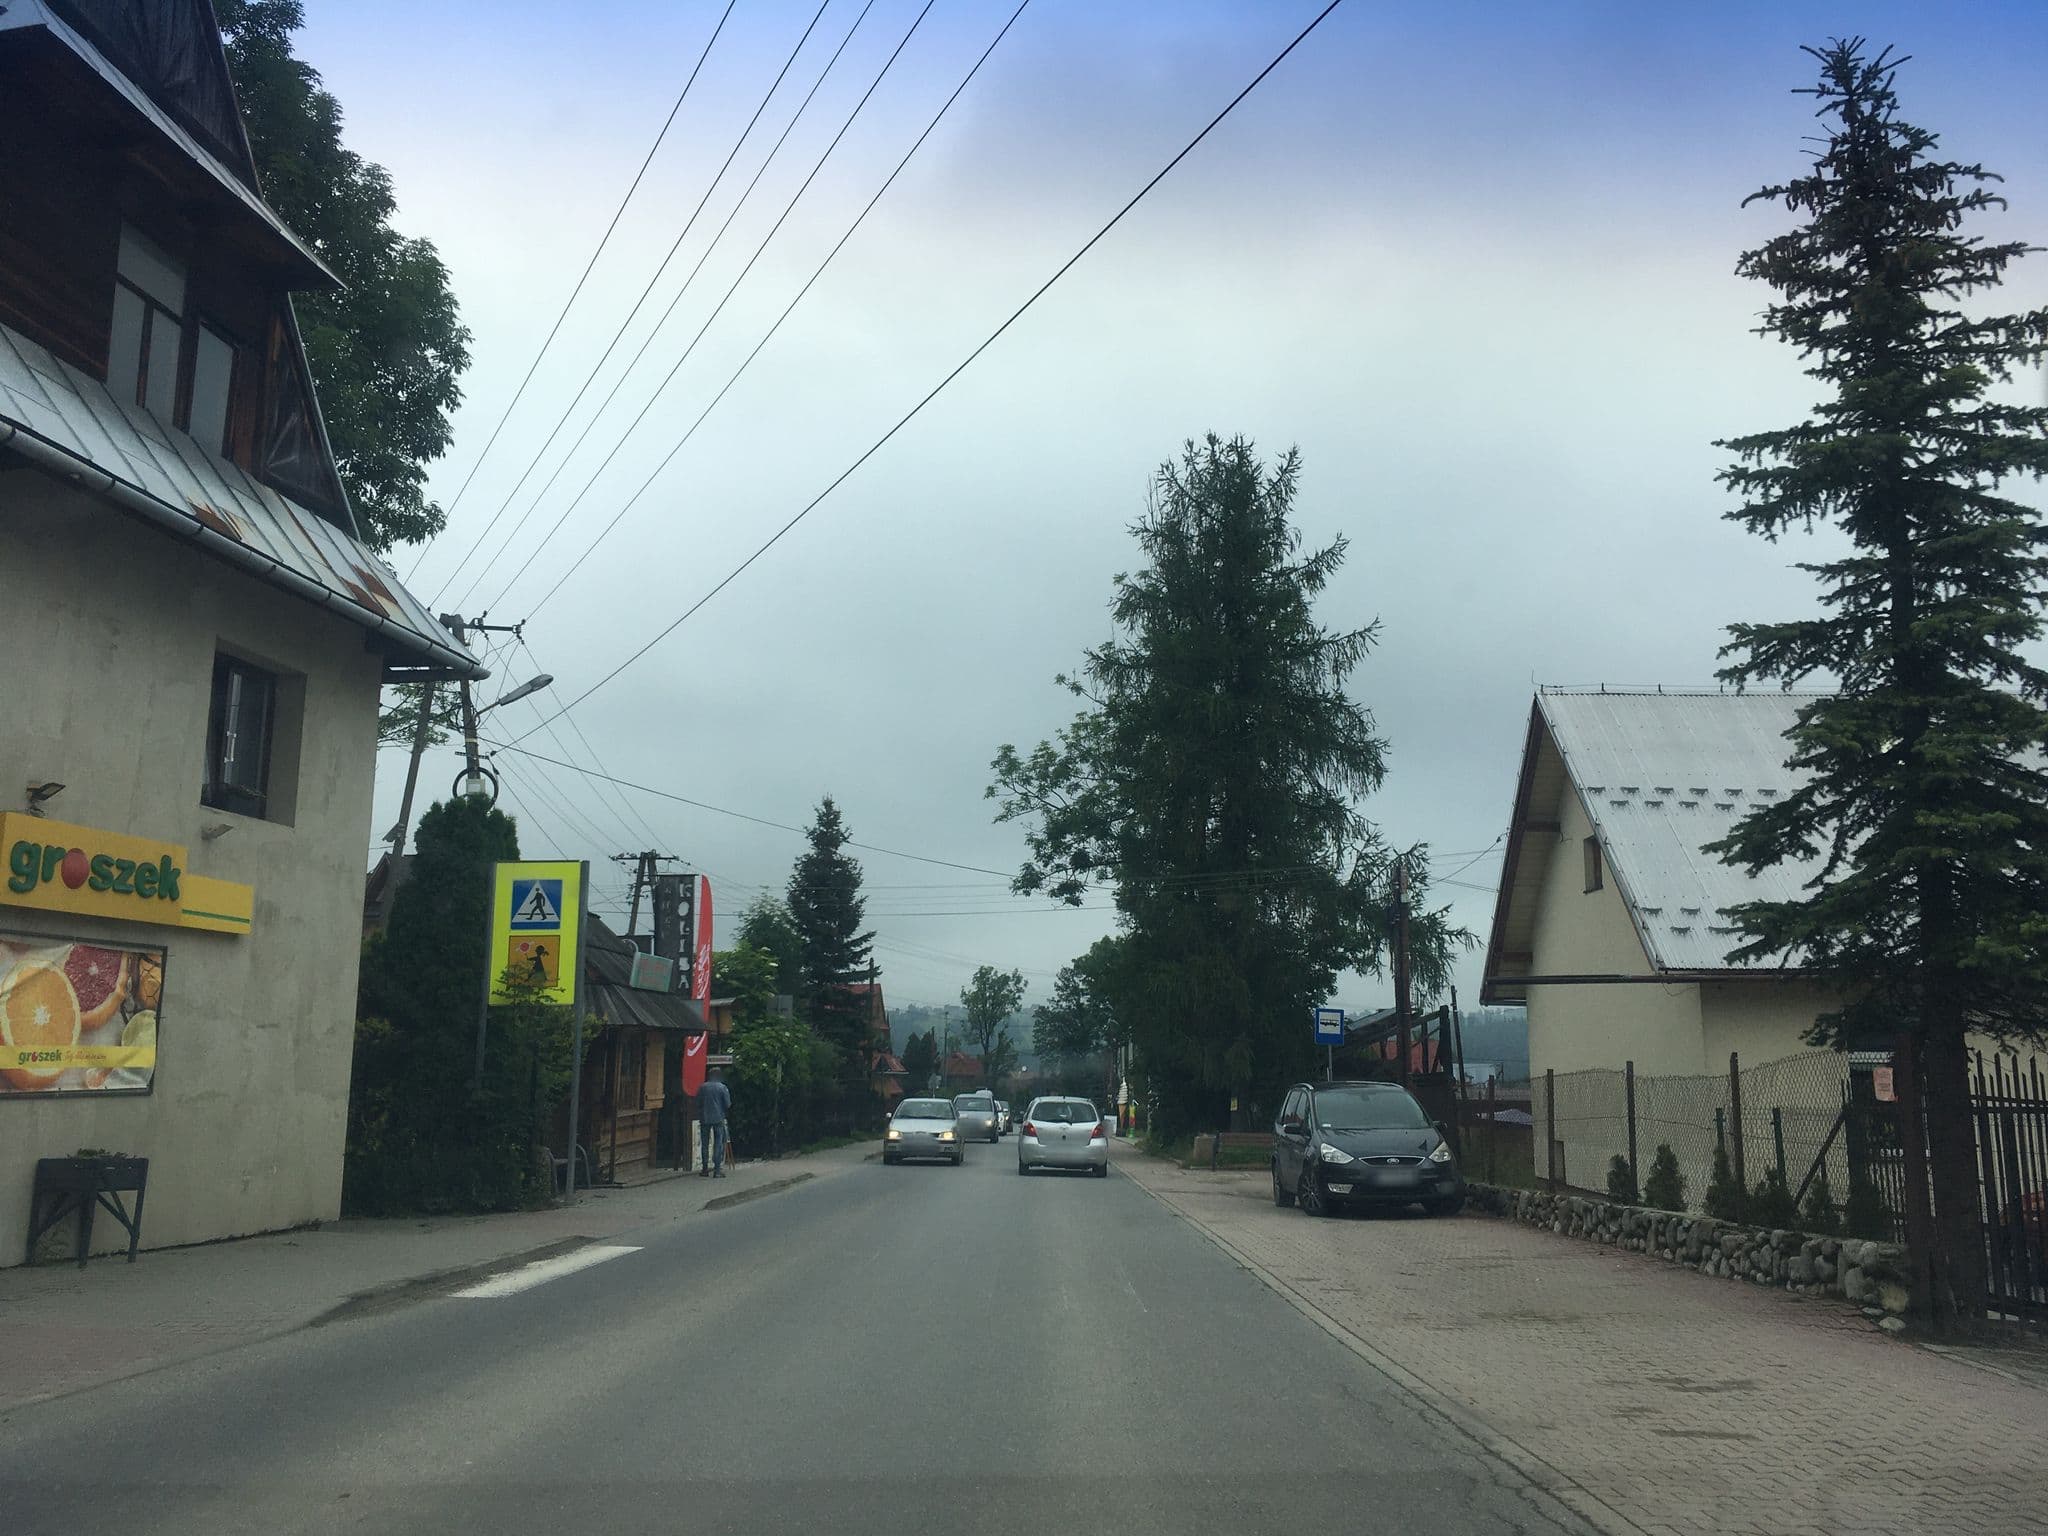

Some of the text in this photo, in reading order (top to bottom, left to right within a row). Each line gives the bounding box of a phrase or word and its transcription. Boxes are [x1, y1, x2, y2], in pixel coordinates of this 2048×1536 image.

[8, 840, 180, 900] groszek
[678, 883, 692, 988] KOLIBA
[18, 1049, 62, 1065] groszek
